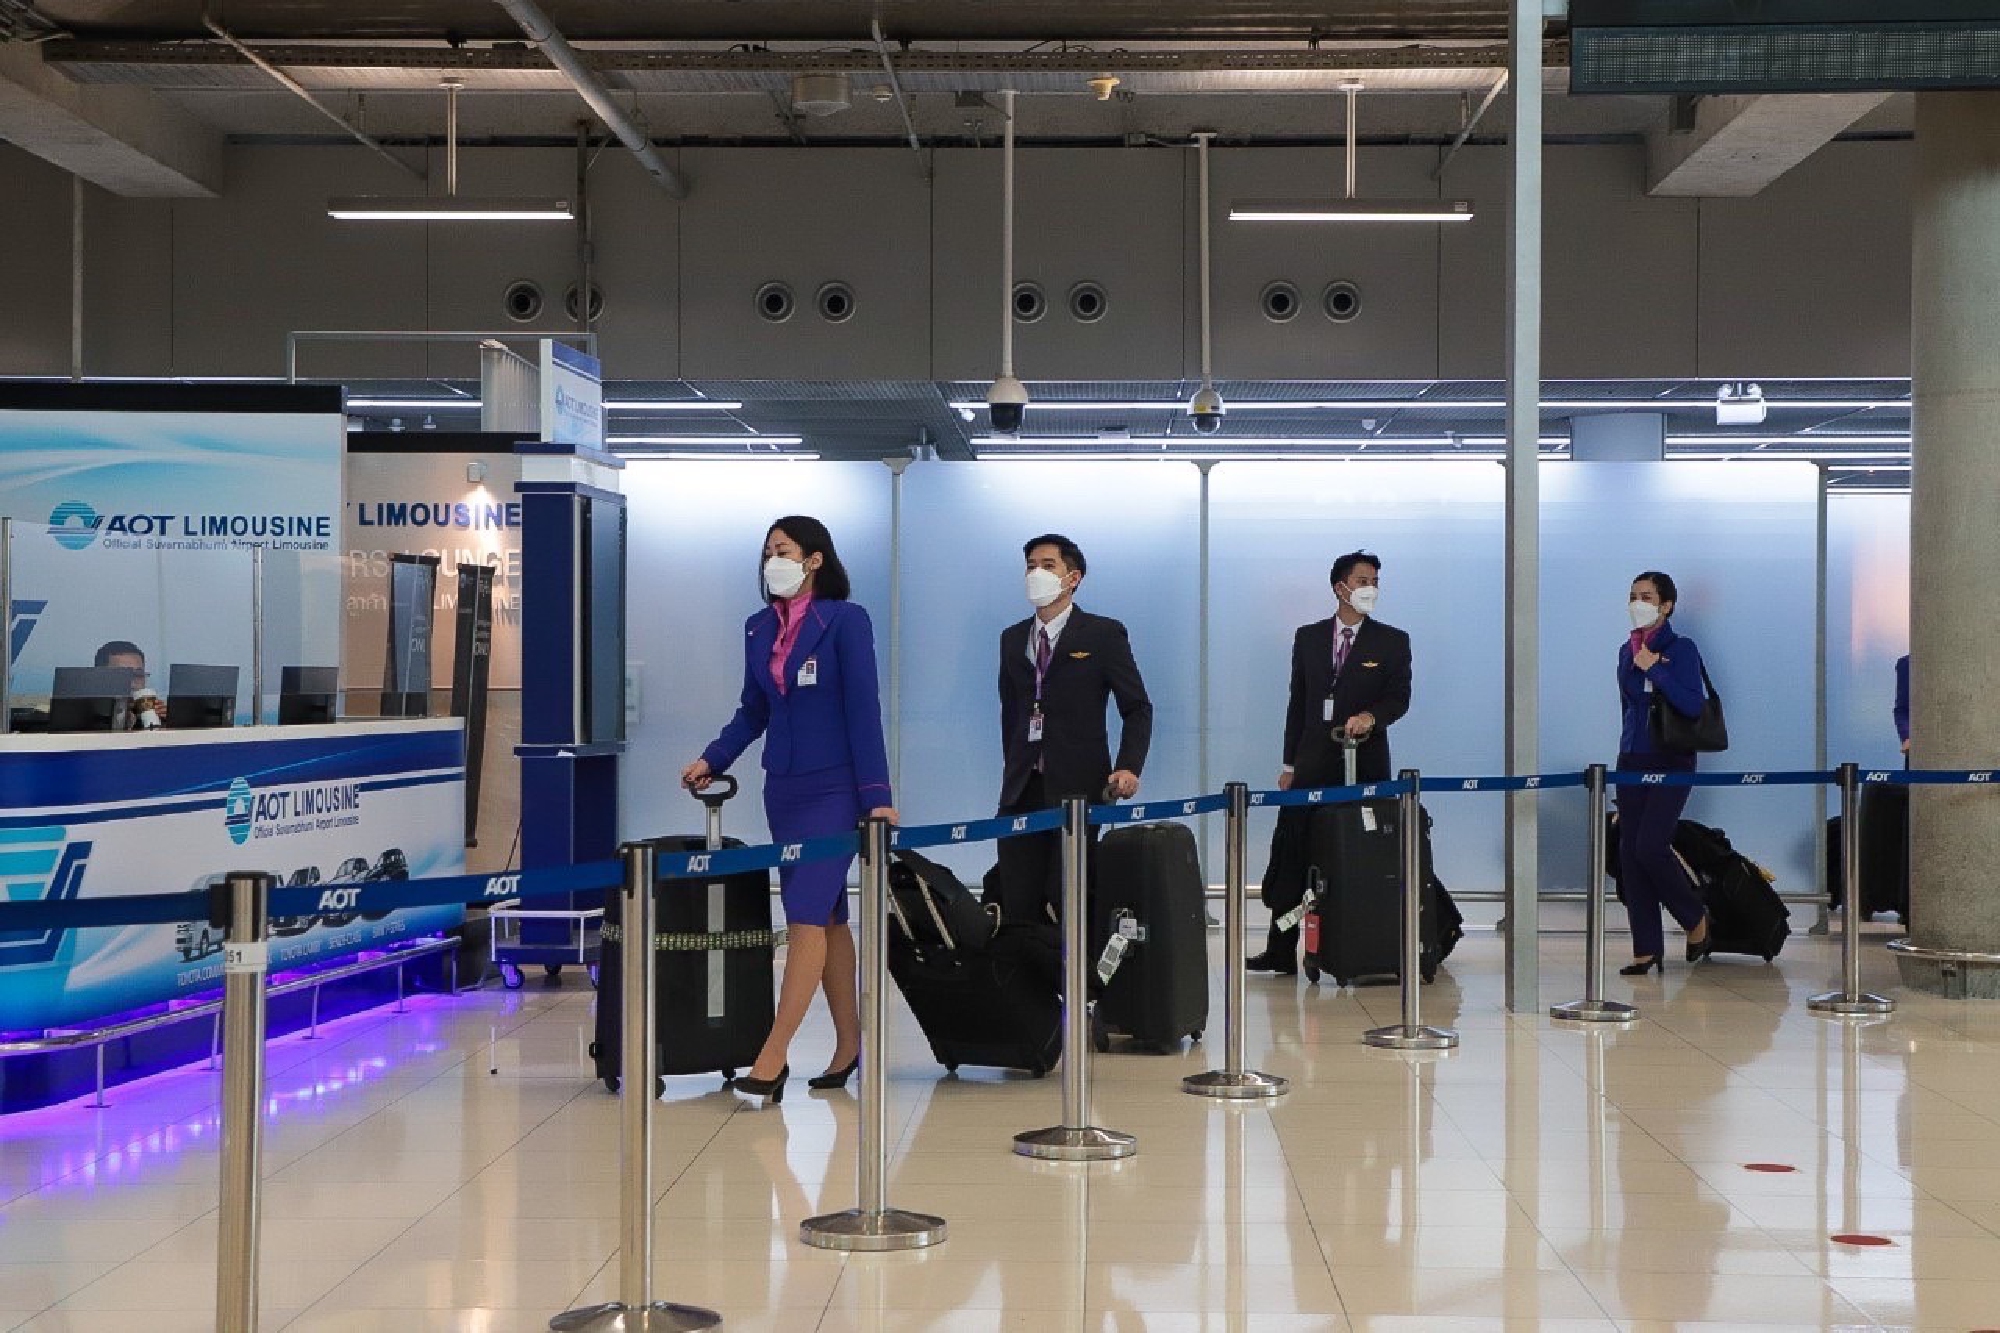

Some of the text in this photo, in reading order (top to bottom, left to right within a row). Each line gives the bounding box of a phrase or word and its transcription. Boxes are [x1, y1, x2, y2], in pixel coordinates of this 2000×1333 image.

[358, 502, 521, 527] LIMOUSINE
[105, 515, 331, 537] AOT LIMOUSINE
[272, 539, 330, 551] Limousine
[1641, 773, 1666, 783] AOT
[1741, 774, 1765, 784] AOT
[1866, 771, 1891, 782] AOT
[1968, 772, 1993, 782] AOT
[255, 783, 360, 822] AOT LIMOUSINE
[781, 843, 803, 862] AOT
[686, 854, 711, 873] AOT
[484, 875, 521, 896] AOT
[318, 888, 362, 911] AOT
